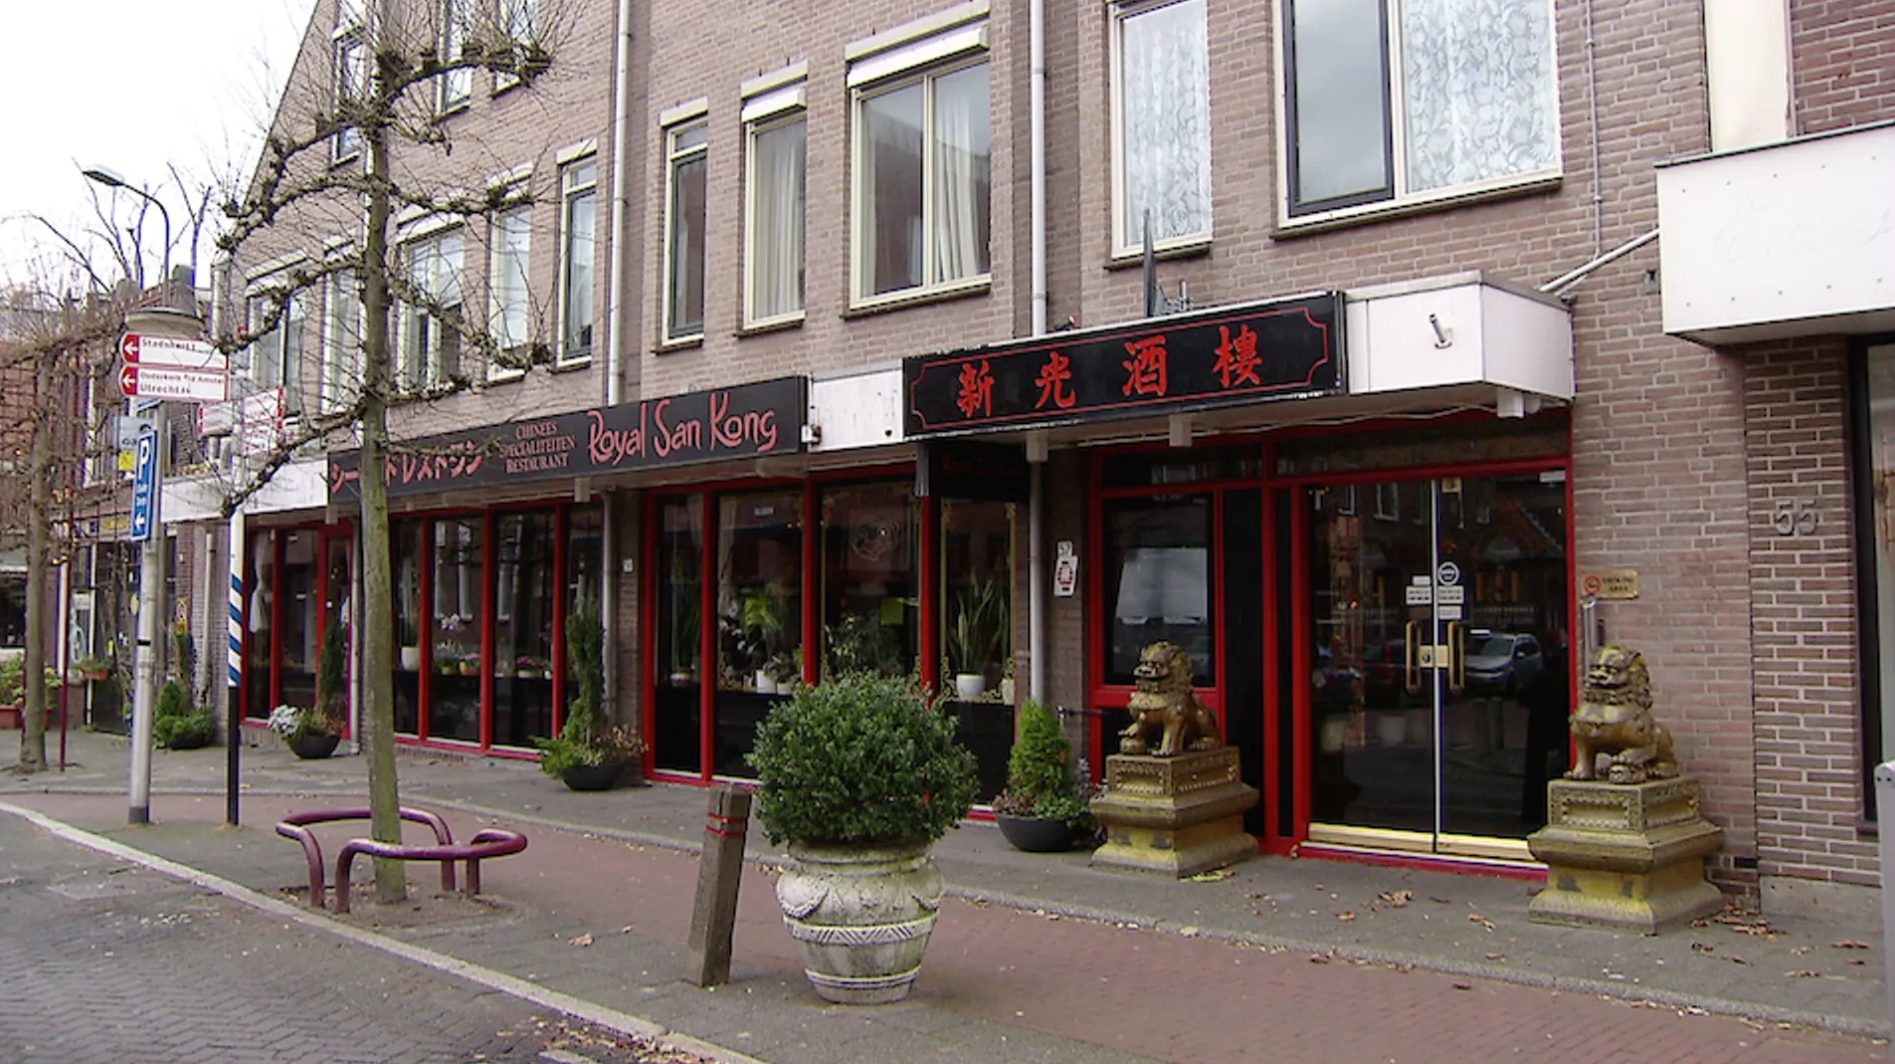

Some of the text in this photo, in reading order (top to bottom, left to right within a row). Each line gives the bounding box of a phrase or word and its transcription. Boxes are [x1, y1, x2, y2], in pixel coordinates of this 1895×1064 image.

[956, 324, 1263, 418] 新光酒樓
[515, 421, 558, 440] CHINEES
[587, 391, 778, 466] Royal San Kong
[506, 452, 569, 474] RESTAURANT
[1774, 499, 1818, 537] 55
